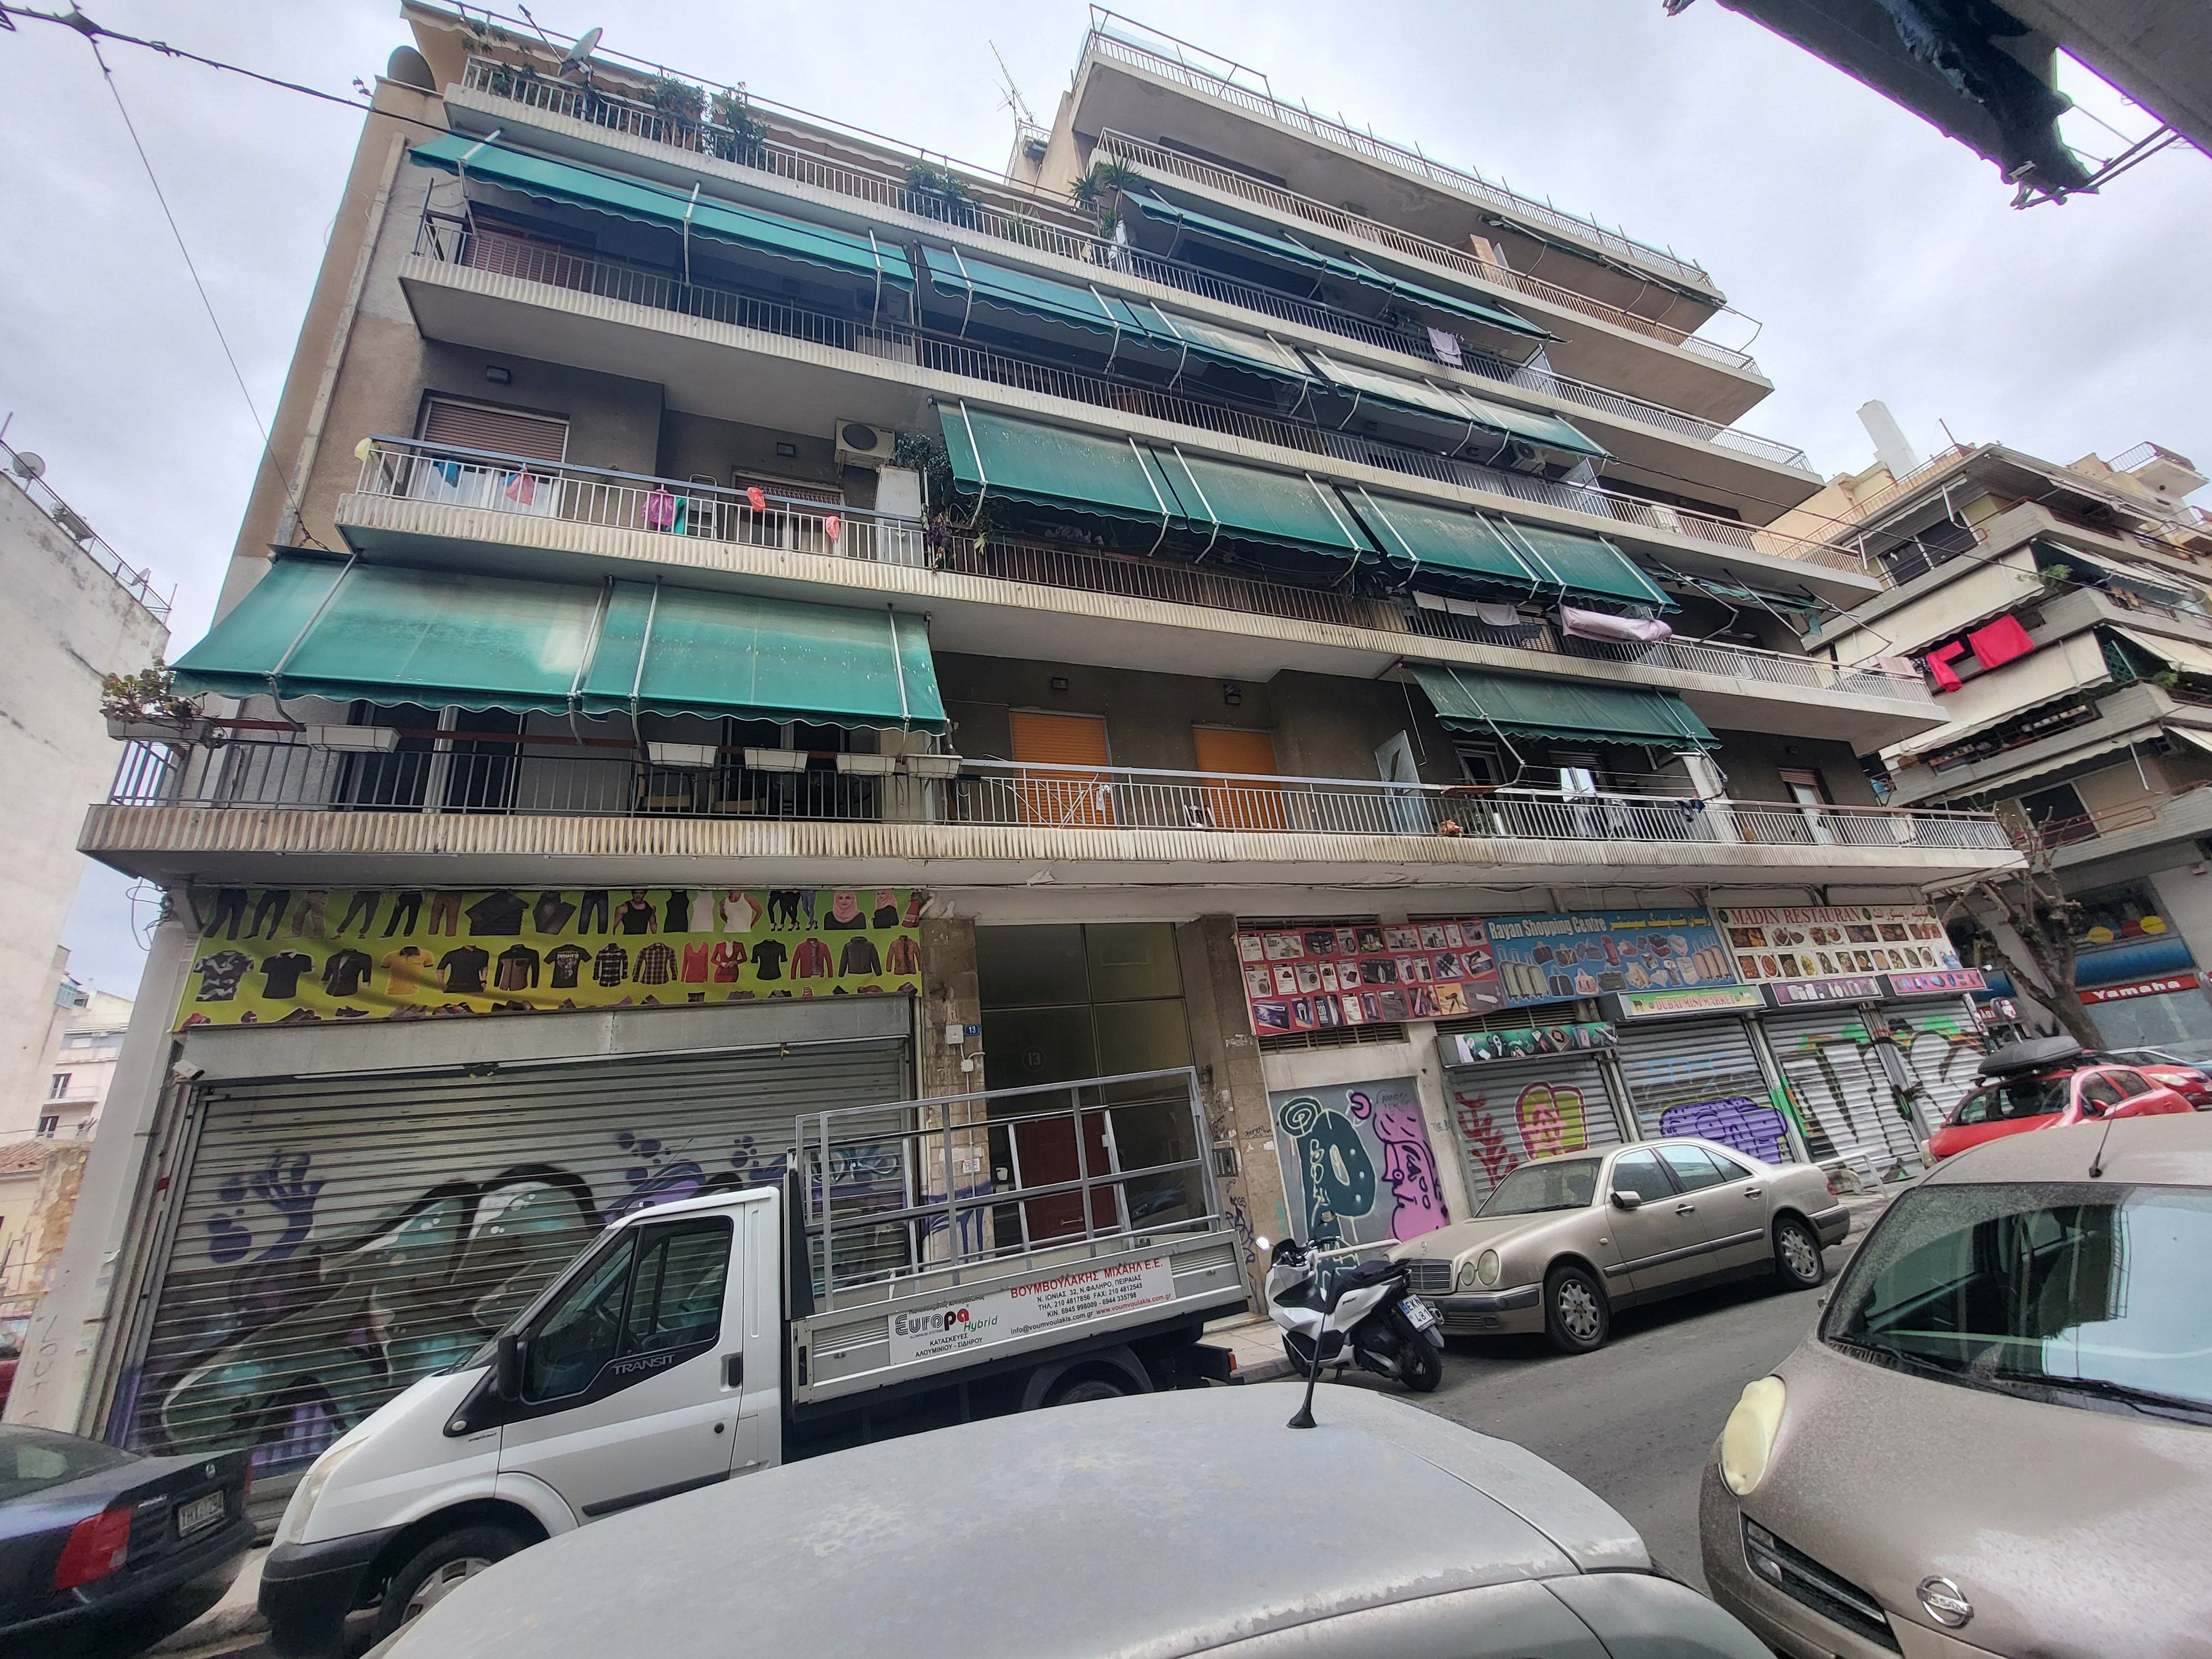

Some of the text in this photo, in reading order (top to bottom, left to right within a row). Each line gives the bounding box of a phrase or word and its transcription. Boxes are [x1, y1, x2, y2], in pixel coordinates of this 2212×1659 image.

[1730, 907, 1861, 925] MADIN RESTAURAN
[1488, 916, 1607, 940] Rayan Shopping Centre
[2093, 980, 2181, 999] Yamaha
[1317, 1005, 1327, 1015] 200
[1655, 994, 1735, 1010] DUBAI MINI MARKET
[1028, 1052, 1041, 1066] 13
[1011, 1258, 1164, 1298] ΒΟΥΜΒΟΥΛΑΚΗΣ ΜΙΧΑΗΛ Ε.Ε.
[1047, 1291, 1067, 1301] ΙΩΝΙΑΣ
[1115, 1274, 1142, 1286] ΠΕΙΡΑΙΑΣ
[1093, 1290, 1107, 1299] FAX:
[1120, 1282, 1143, 1293] 4812545
[1061, 1305, 1076, 1315] 6945
[1077, 1301, 1098, 1311] 998009
[1102, 1296, 1116, 1306] 6944
[1117, 1292, 1137, 1302] 335798
[1066, 1293, 1091, 1305] 4817856
[1095, 1293, 1172, 1316] www.voumvoulakis.com.gr
[964, 1315, 998, 1333] Hybrid
[1415, 1308, 1431, 1322] 481
[915, 1344, 952, 1358] ΑΛΟΥΜΙΝΙΟΥ
[957, 1337, 983, 1348] ΣΙΔΗΡΟΥ
[930, 1333, 968, 1347] ΚΑΤΑΣΚΕΥΕΣ
[612, 1354, 675, 1375] TRANSIT
